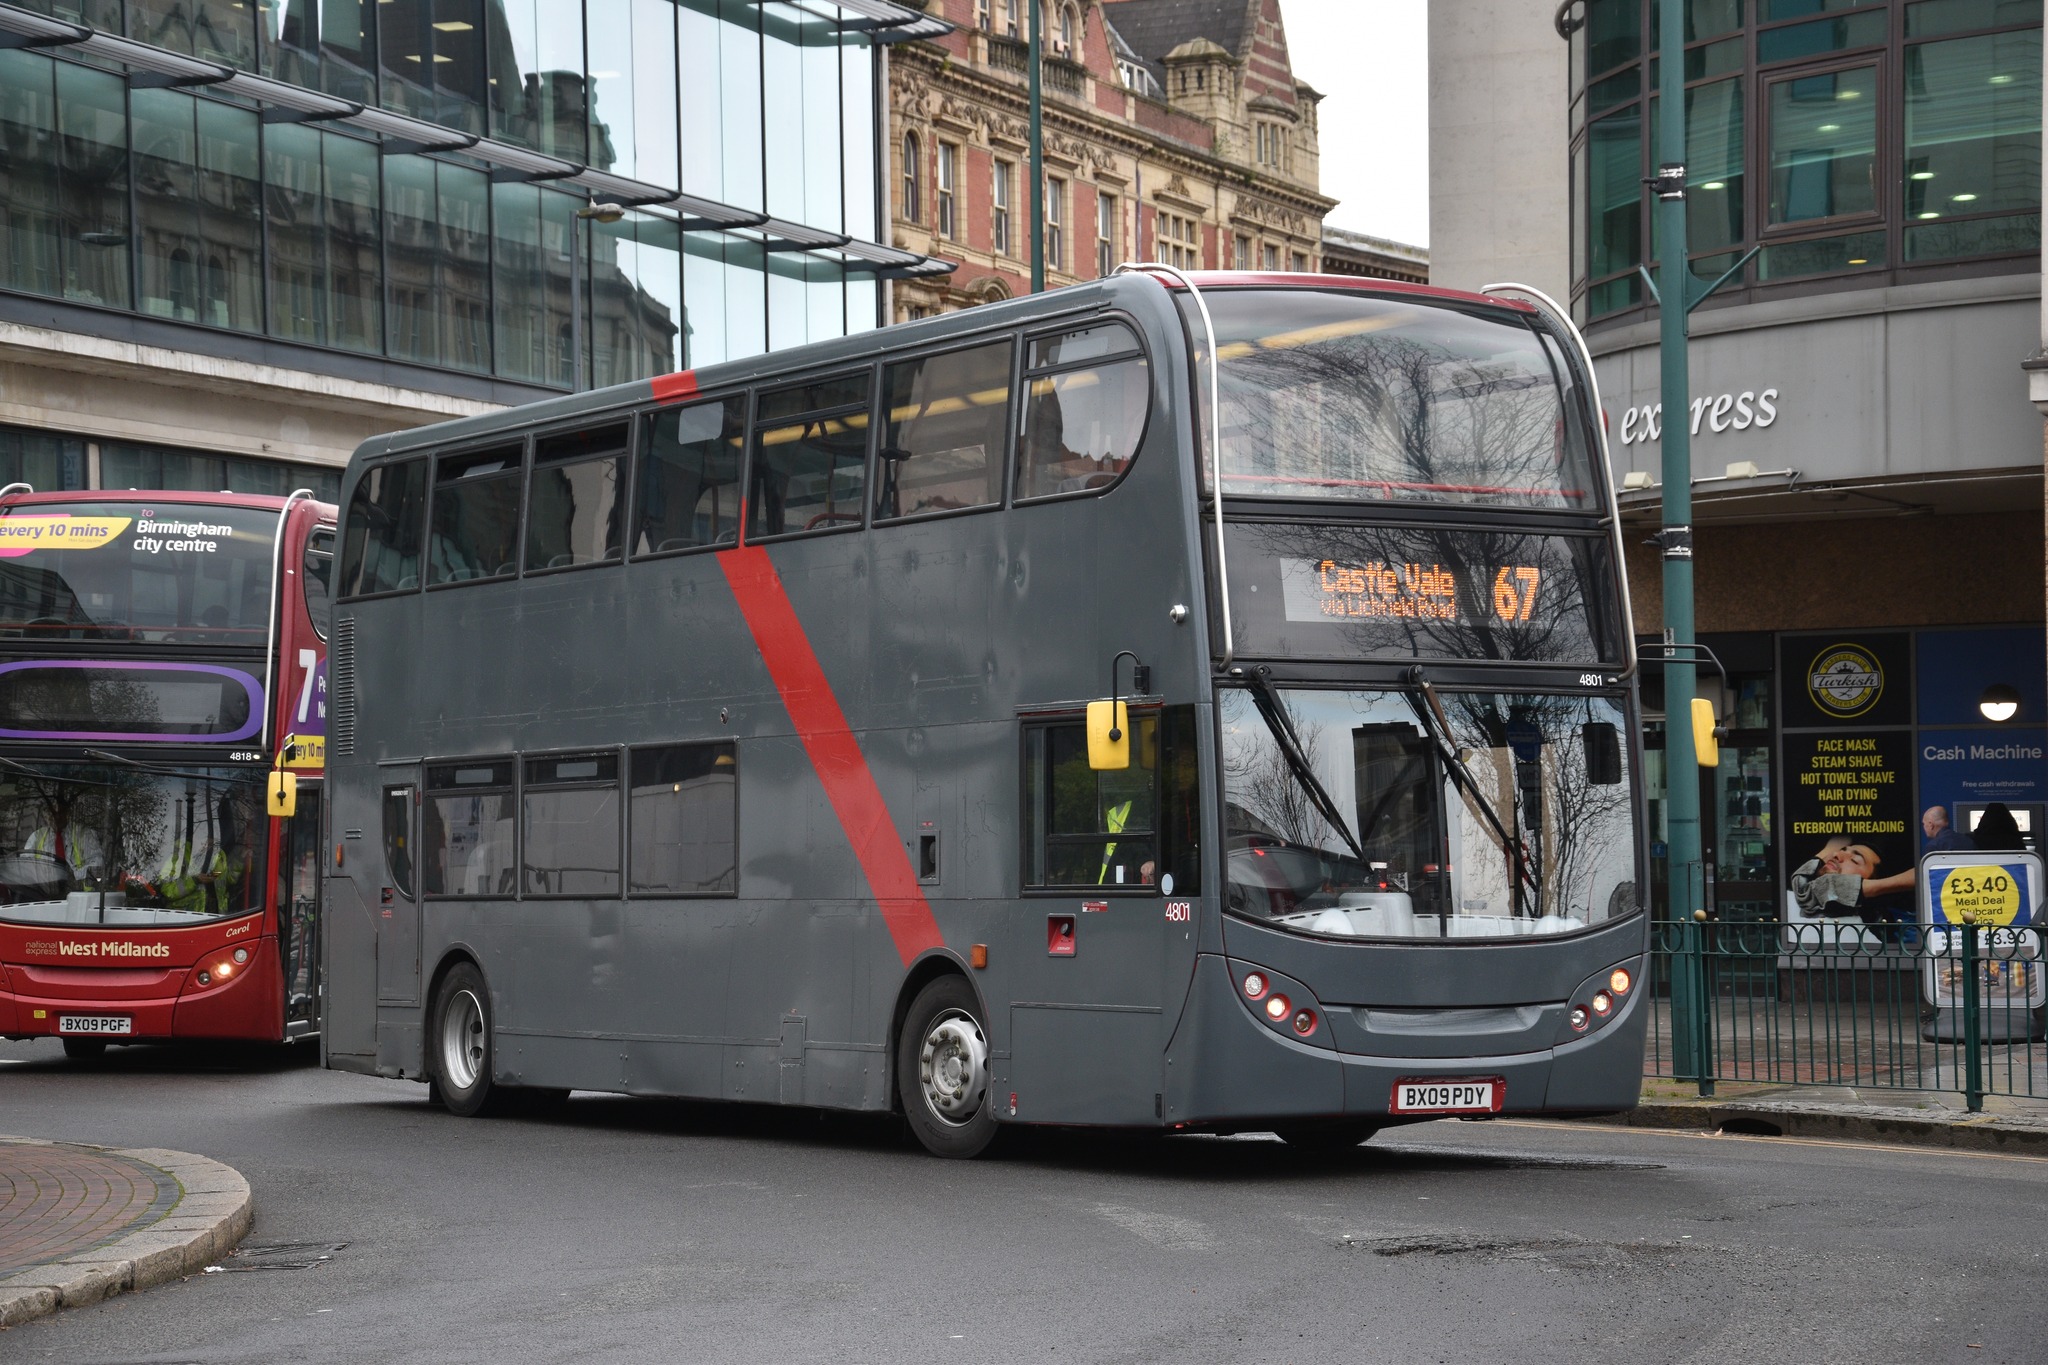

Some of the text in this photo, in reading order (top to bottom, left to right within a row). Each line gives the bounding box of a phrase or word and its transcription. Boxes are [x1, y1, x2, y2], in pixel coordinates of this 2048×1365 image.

[1620, 388, 1778, 444] exress
[141, 508, 154, 518] to
[0, 524, 108, 539] every 10 mins
[136, 520, 232, 538] Birmingham
[133, 536, 217, 554] city centre
[1320, 560, 1540, 620] Castle Vale 67
[1321, 594, 1456, 619] via Lichfield Road
[298, 648, 316, 723] 7
[318, 676, 326, 693] Pe
[1579, 674, 1603, 686] 4801
[1814, 674, 1877, 687] Turkish
[296, 745, 306, 760] ery
[308, 742, 315, 757] 10
[1817, 739, 1876, 752] FACE MASK
[1924, 744, 2042, 760] Cash Machine
[230, 752, 251, 760] 4818
[1812, 755, 1883, 768] STEAM SHAVE
[1801, 771, 1895, 784] HOT TOWEL SHAVE
[1818, 788, 1877, 801] HAIR DYING
[1825, 805, 1872, 817] HOT WAX
[1794, 821, 1904, 834] EYEBROW THREADING
[1951, 876, 2008, 894] £3.40
[1956, 896, 2005, 906] Meal Deal
[1165, 902, 1190, 921] 4801
[226, 922, 250, 938] Carol
[1984, 929, 2026, 945] £3.90
[25, 948, 58, 956] express
[59, 941, 170, 957] West Midlands
[101, 1019, 125, 1031] PGF
